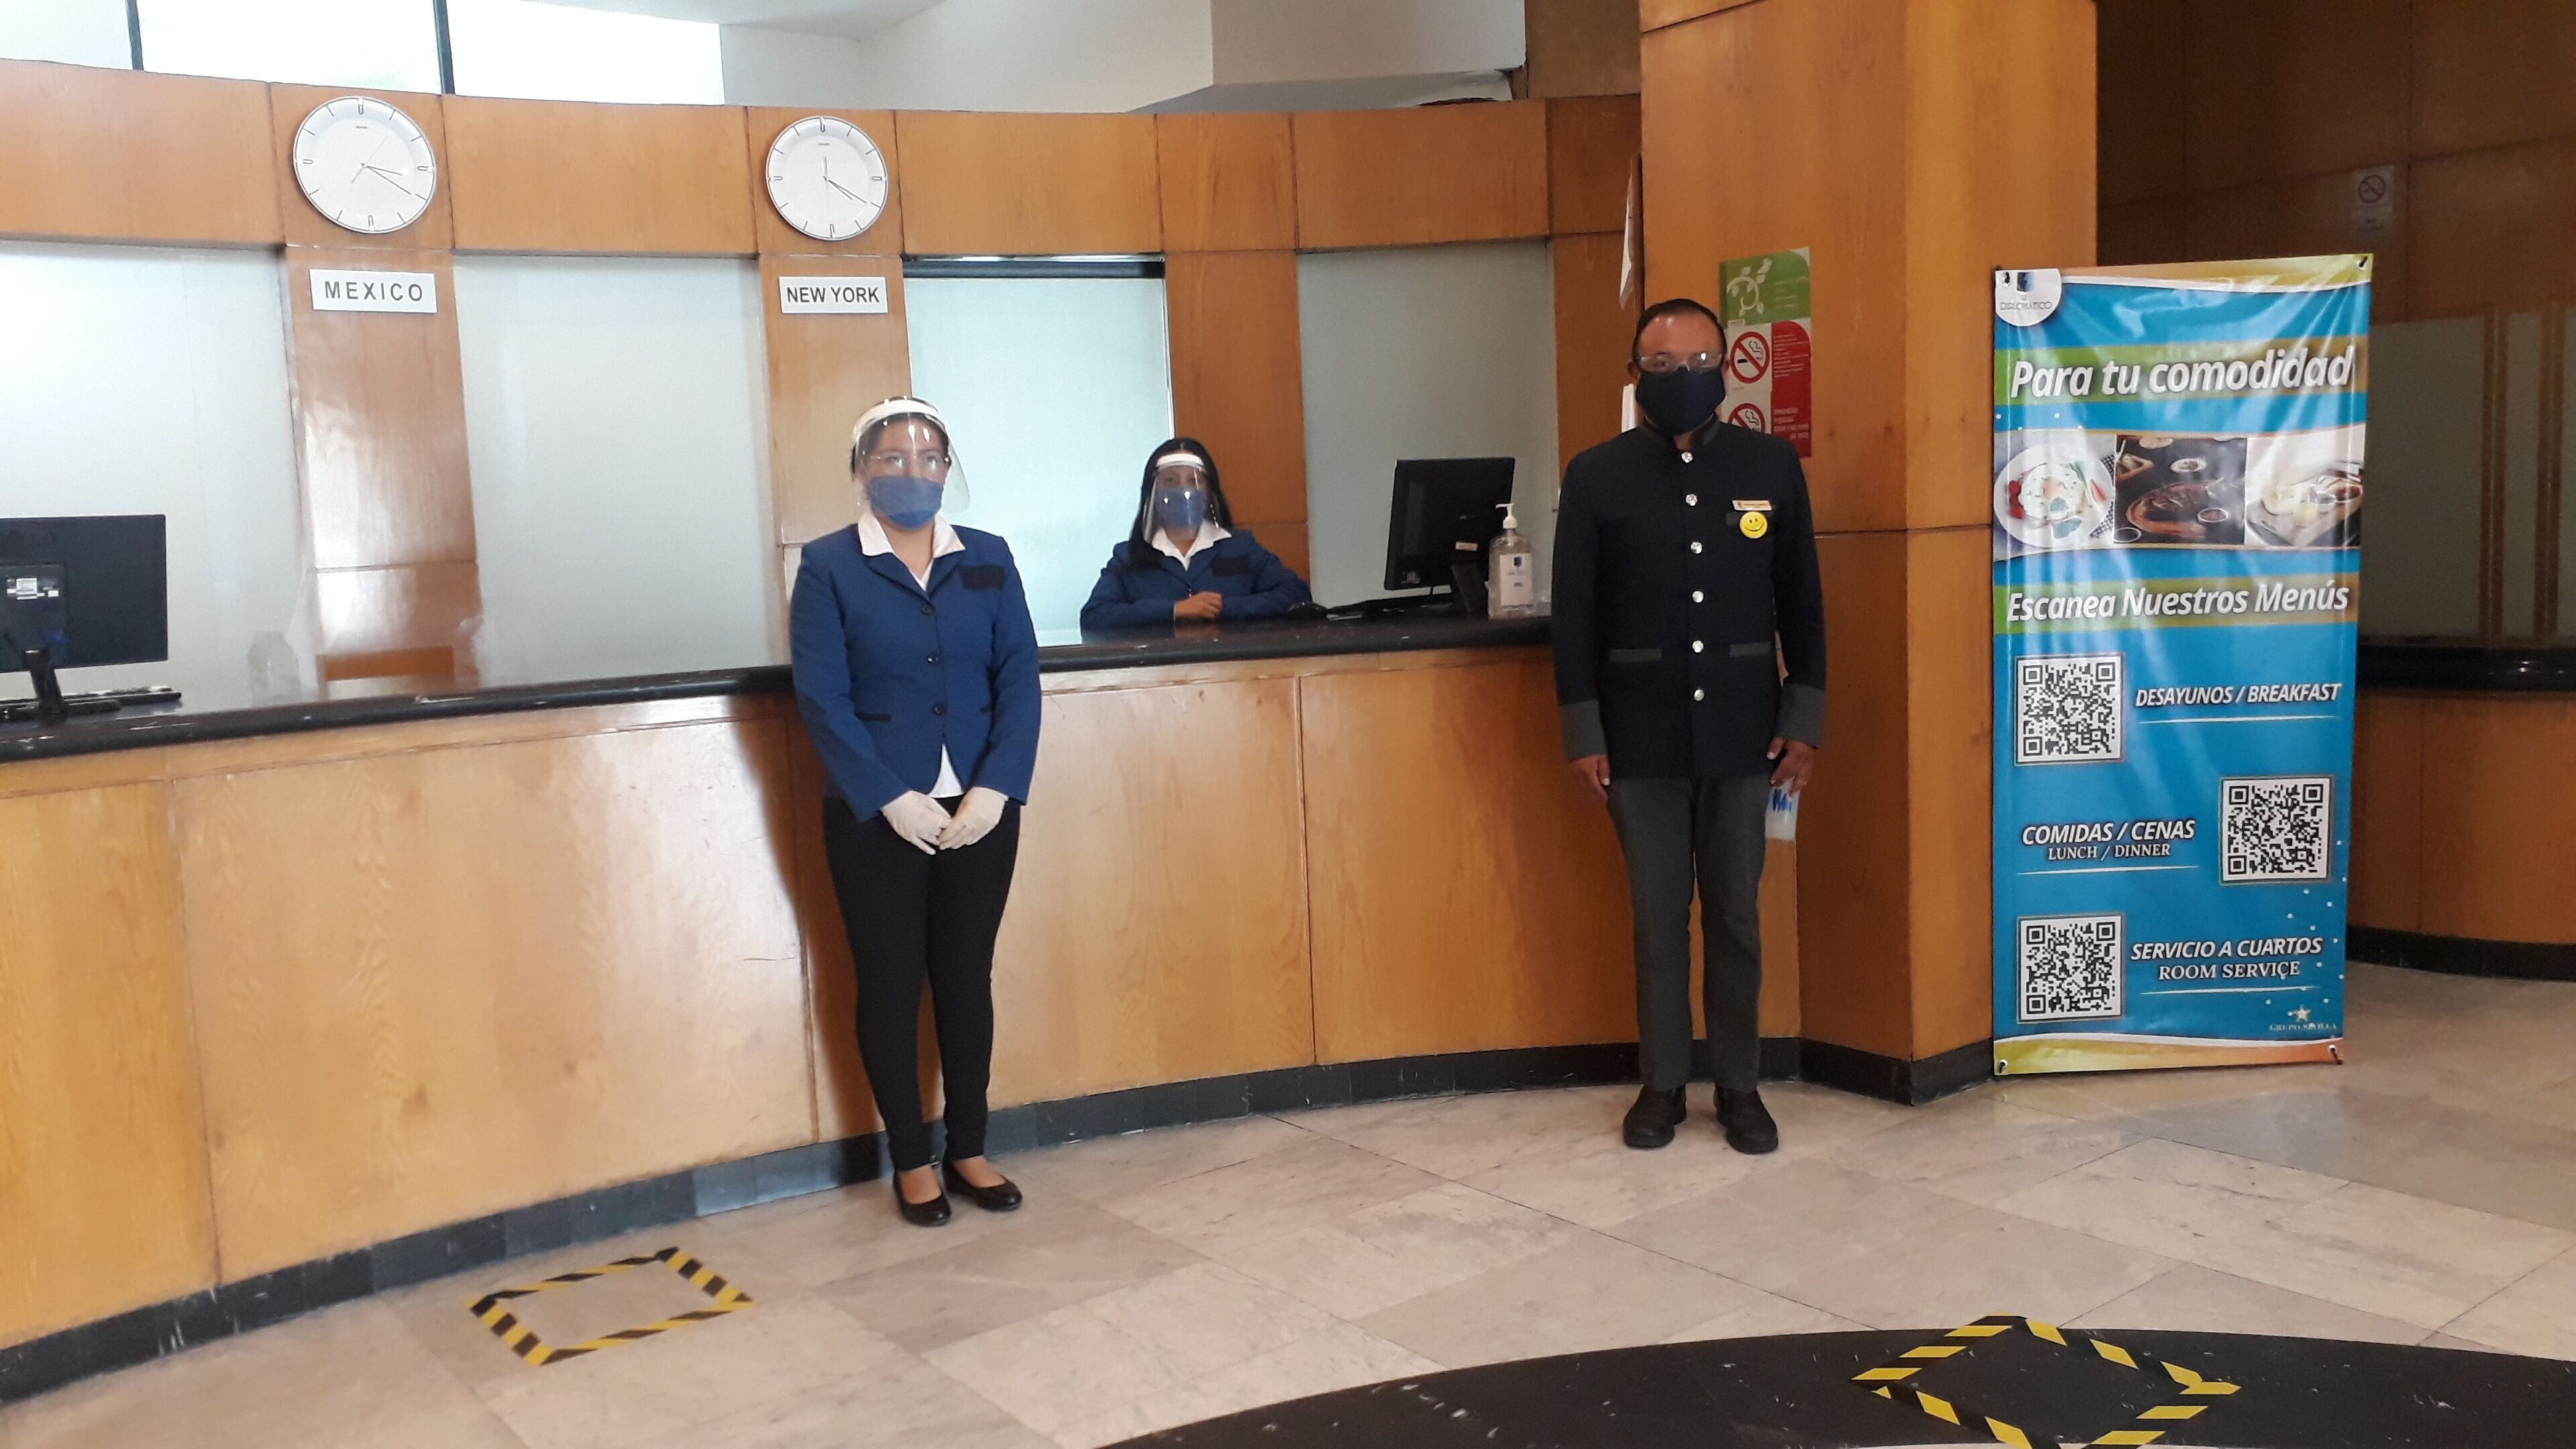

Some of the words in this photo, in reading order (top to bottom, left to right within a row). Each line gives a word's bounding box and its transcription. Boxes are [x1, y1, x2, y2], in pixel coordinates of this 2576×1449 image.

[325, 280, 423, 301] MEXICO
[787, 287, 826, 303] NEW
[830, 287, 880, 303] YORK
[2010, 360, 2093, 398] Para
[2101, 360, 2141, 394] tu
[2149, 345, 2355, 393] comodidad
[2007, 592, 2115, 621] Escanea
[2121, 586, 2247, 616] Nuestros
[2254, 580, 2350, 612] Menús
[2136, 686, 2233, 706] DESAYUNOS
[2235, 686, 2245, 703] /
[2247, 683, 2342, 702] BREAKFAST
[2023, 823, 2114, 845] COMIDAS
[2116, 822, 2129, 841] /
[2131, 820, 2196, 841] CENAS
[2048, 846, 2098, 860] LUNCH
[2100, 845, 2110, 861] /
[2114, 843, 2170, 857] DINNER
[2131, 941, 2215, 960] SERVICIO
[2217, 941, 2232, 957] A
[2237, 937, 2323, 956] CUARTOS
[2159, 965, 2216, 980] ROOM
[2222, 961, 2300, 979] SERVICE
